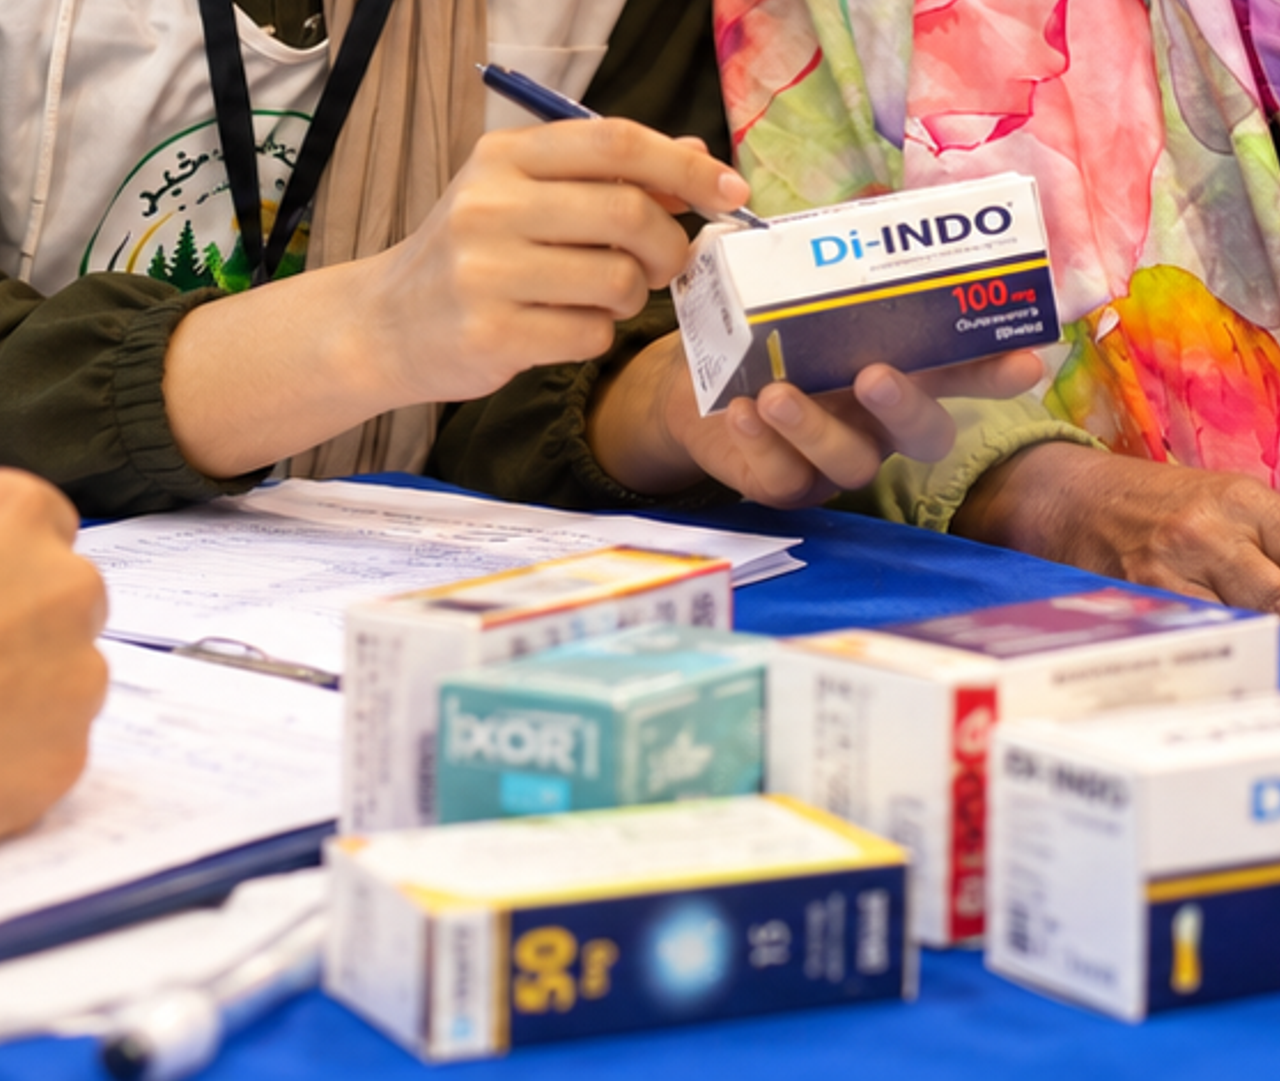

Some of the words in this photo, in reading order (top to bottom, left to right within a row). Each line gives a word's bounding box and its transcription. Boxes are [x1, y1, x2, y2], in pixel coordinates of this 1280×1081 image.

[809, 205, 1013, 268] Di-INDO
[952, 278, 1008, 314] 100
[513, 925, 578, 1015] 50
